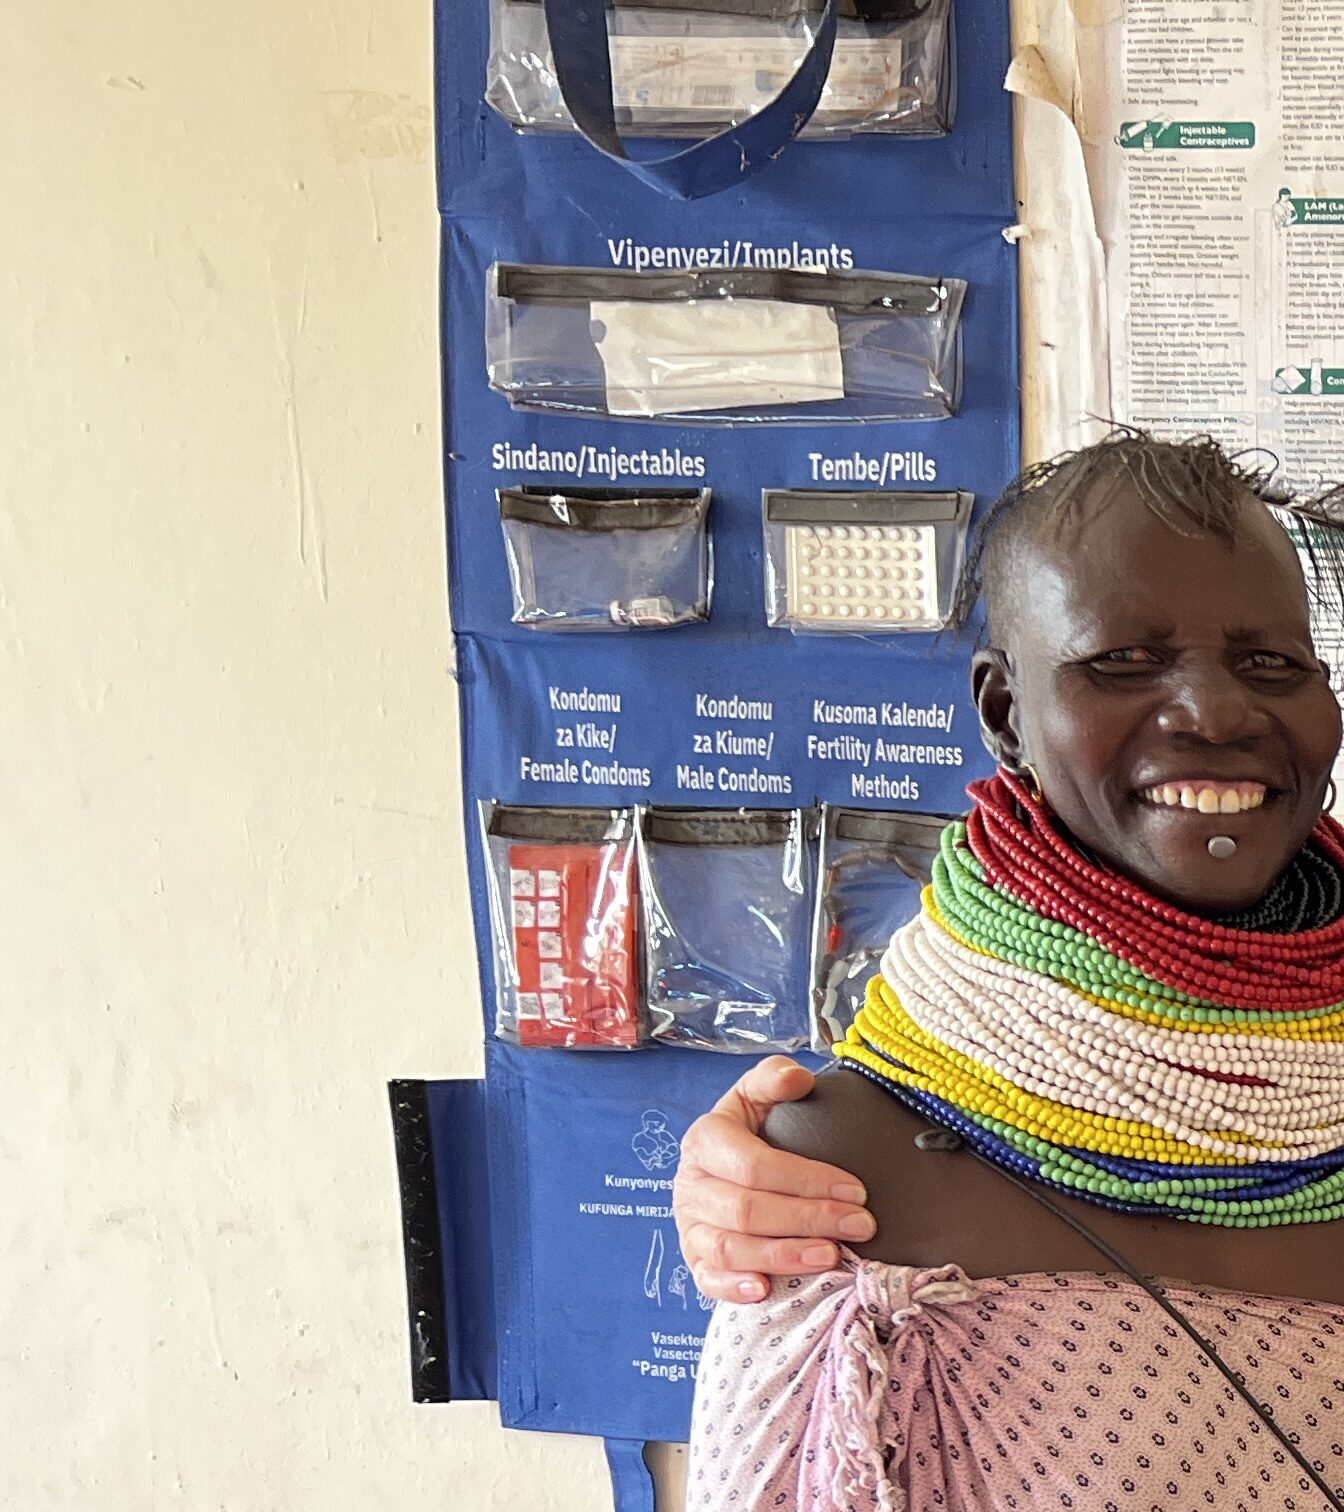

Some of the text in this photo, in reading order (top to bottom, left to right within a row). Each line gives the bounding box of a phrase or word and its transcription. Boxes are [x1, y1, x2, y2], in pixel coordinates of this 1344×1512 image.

[1179, 126, 1226, 136] Injectable
[1180, 137, 1249, 147] Contraceptives
[1304, 202, 1327, 210] LAM
[608, 239, 853, 271] Vipenyezi/Implants
[492, 443, 705, 480] Sindano/Injectables
[809, 453, 936, 485] Tembe/Pills
[549, 687, 621, 714] Kondomu
[696, 694, 773, 721] Kondomu
[813, 700, 955, 733] Kusoma Kalenda/
[556, 724, 617, 750] za Kike/
[693, 732, 774, 759] za Kiume/
[807, 735, 963, 766] Fertility Awareness
[521, 761, 651, 788] Female Condoms
[677, 766, 792, 794] Male Condoms
[851, 774, 919, 800] Methods
[605, 1175, 673, 1191] Kunyonyes
[579, 1204, 633, 1216] KUFUNGA
[654, 1347, 701, 1360] Vasecto
